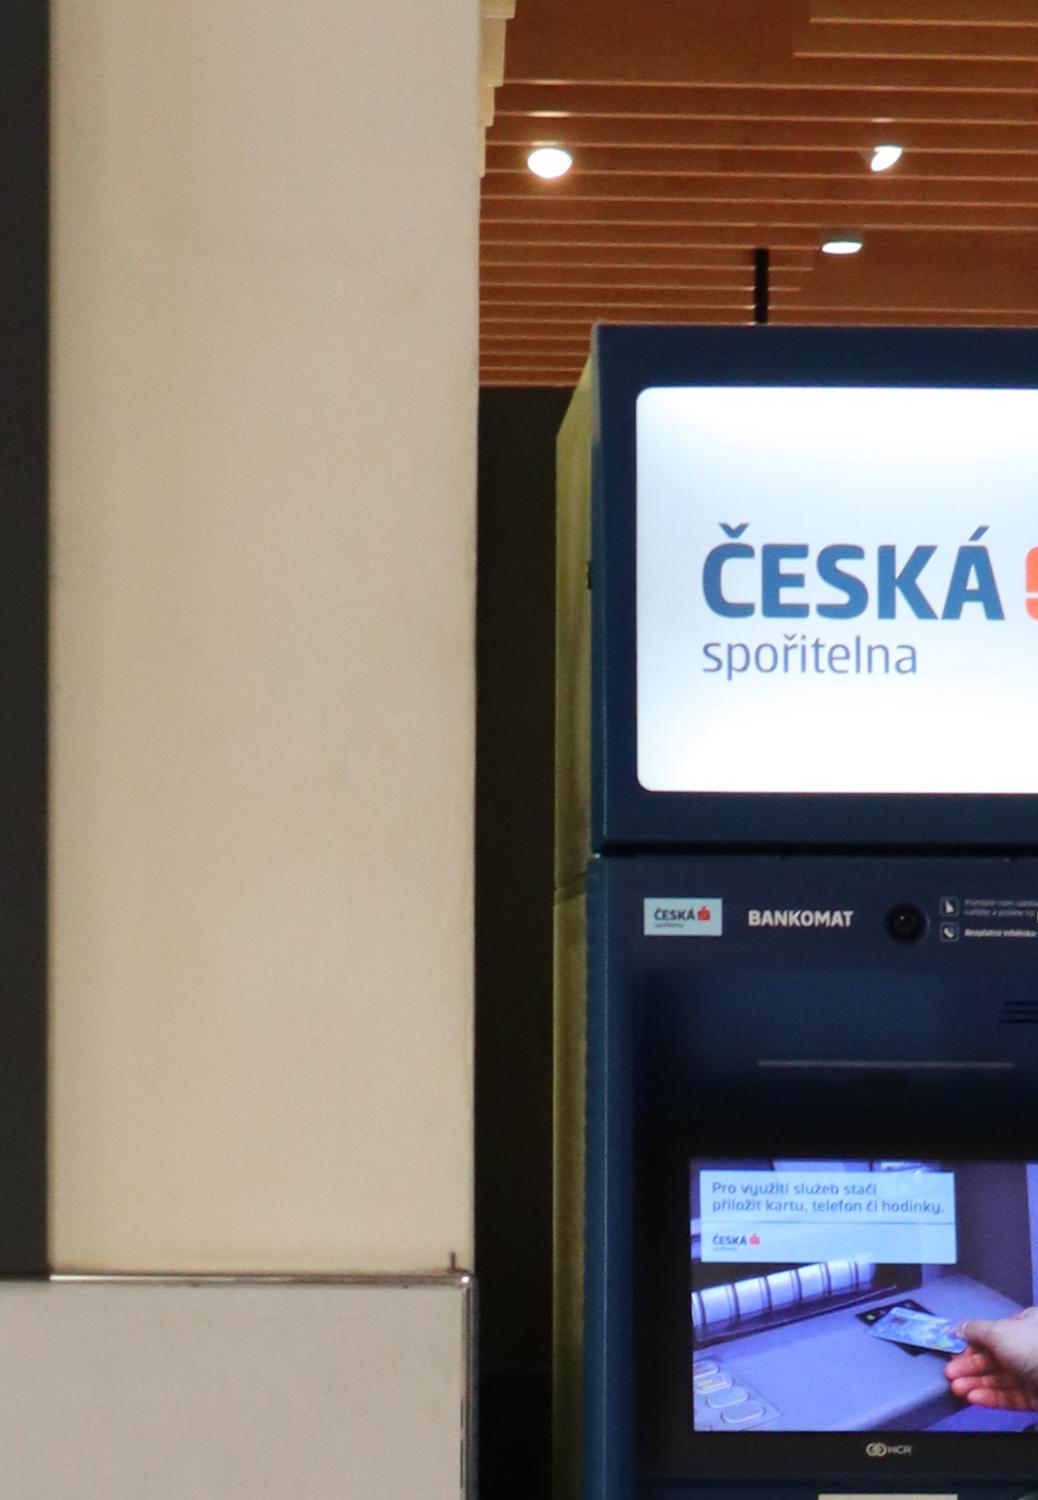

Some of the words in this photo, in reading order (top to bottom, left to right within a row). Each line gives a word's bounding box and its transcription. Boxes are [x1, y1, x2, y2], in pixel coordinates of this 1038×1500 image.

[702, 523, 1005, 621] ČESKÁ
[702, 634, 918, 682] spořitelna
[654, 906, 695, 921] ČESKÁ
[748, 910, 854, 927] BANKOMAT
[713, 1182, 737, 1195] Pro
[741, 1181, 789, 1197] využití
[793, 1181, 839, 1196] služeb
[843, 1182, 877, 1196] stačí
[712, 1200, 762, 1214] přiložit
[812, 1199, 862, 1213] telefon
[866, 1199, 878, 1212] či
[882, 1200, 945, 1215] hodinky.
[712, 1234, 747, 1246] ČESKÁ
